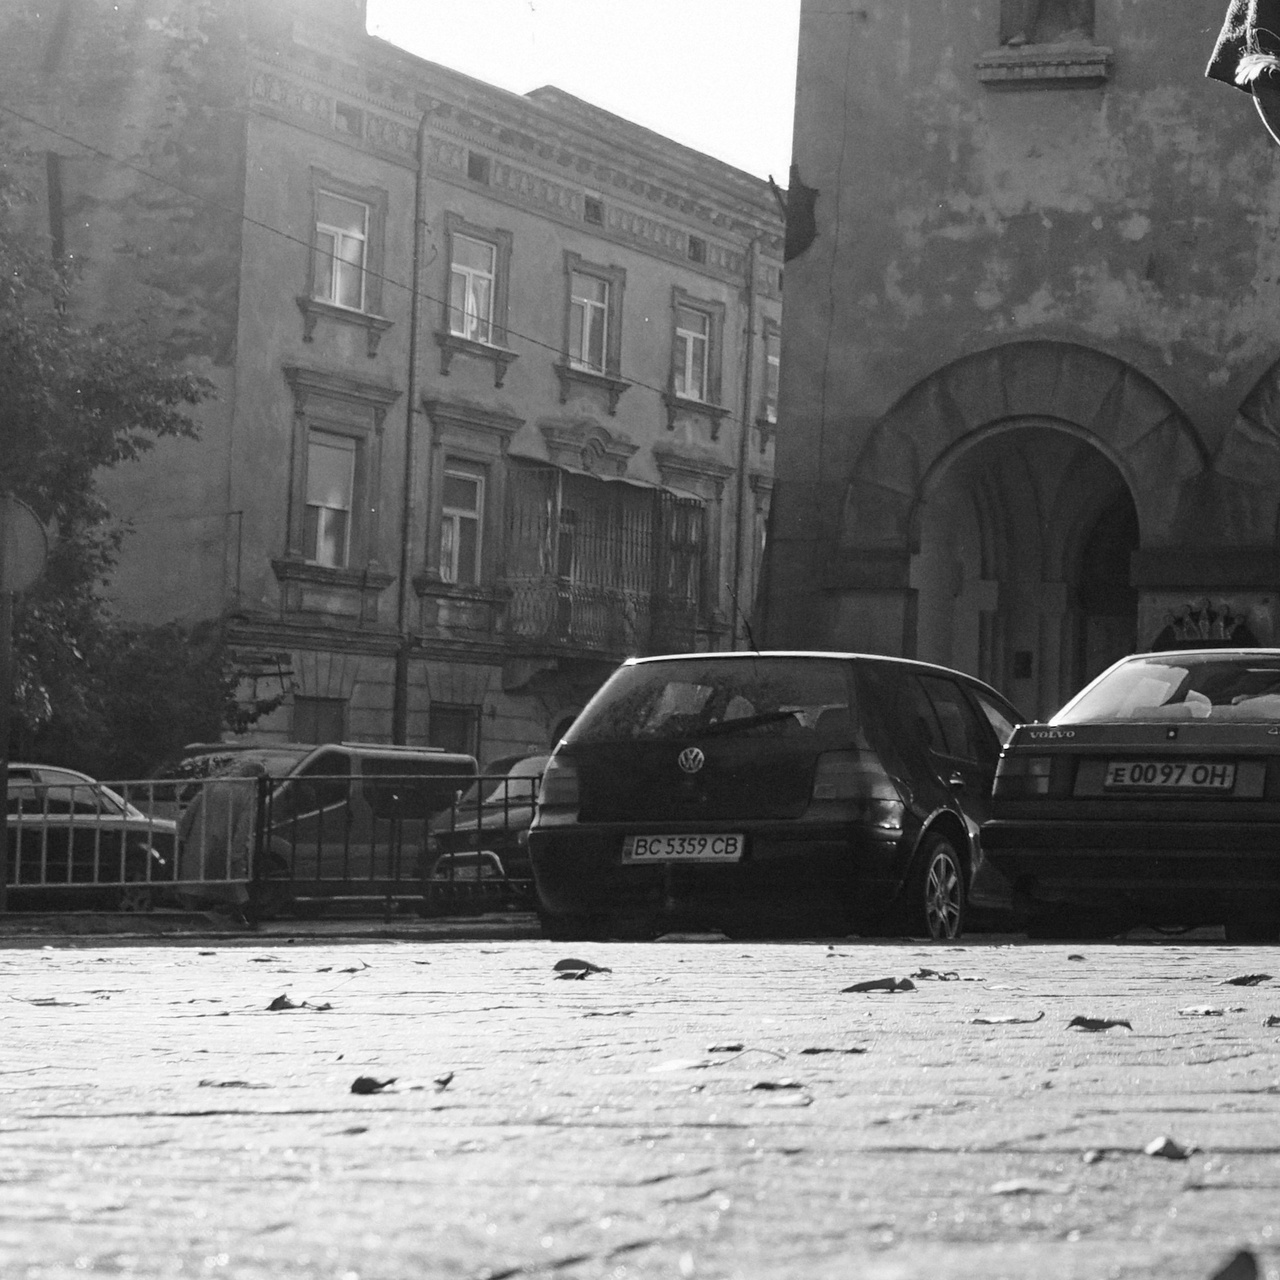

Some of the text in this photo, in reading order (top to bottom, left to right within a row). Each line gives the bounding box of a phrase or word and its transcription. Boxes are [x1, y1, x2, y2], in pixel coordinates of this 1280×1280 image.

[1030, 730, 1076, 738] VOLVO
[1129, 763, 1187, 784] 0097
[1191, 765, 1227, 785] OH
[634, 837, 738, 856] BC 5359 CB
